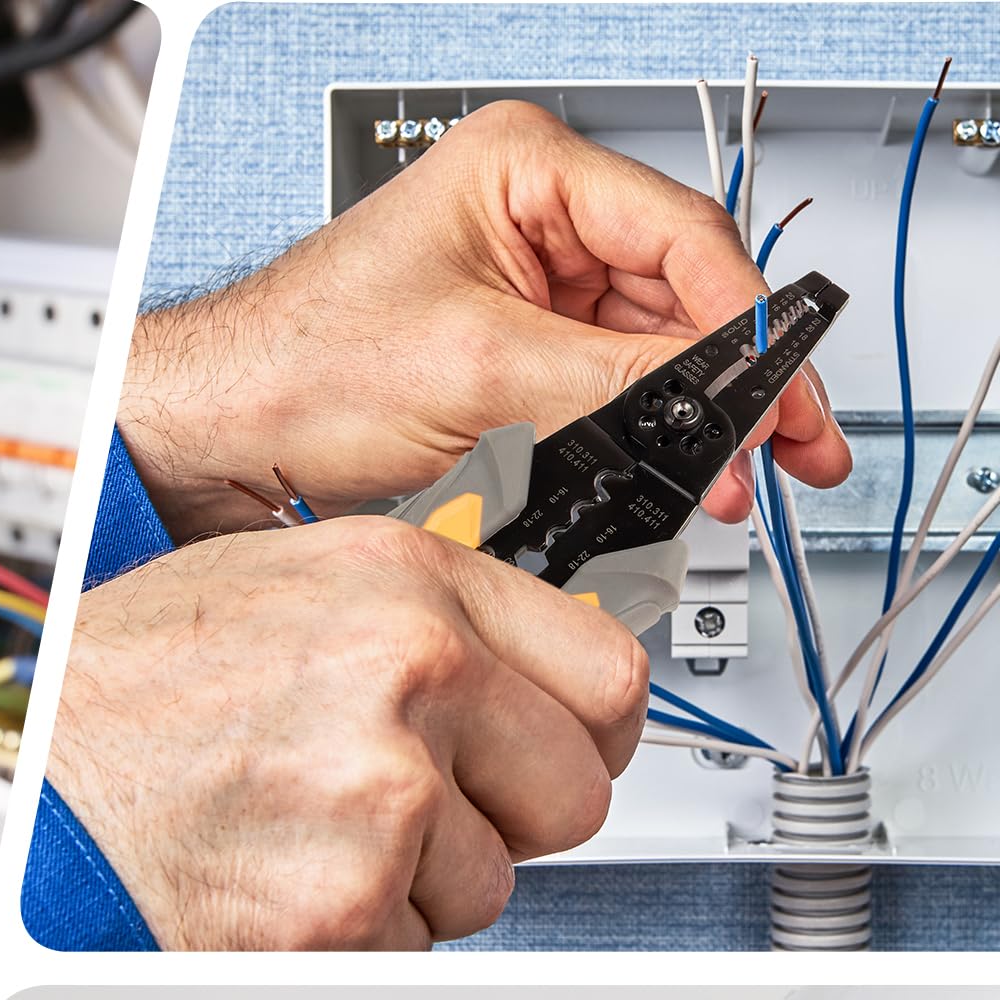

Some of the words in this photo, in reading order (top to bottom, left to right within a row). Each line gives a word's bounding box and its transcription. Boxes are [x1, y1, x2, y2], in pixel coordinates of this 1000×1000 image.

[721, 318, 748, 338] SOLID
[682, 358, 706, 377] SAFETY
[692, 354, 710, 370] WEAR
[768, 352, 800, 384] STRANDED
[674, 363, 700, 385] GLASSES
[558, 446, 590, 473] 410.411
[566, 438, 598, 466] 310.311
[548, 486, 569, 504] 16-10
[627, 502, 662, 530] 410.411
[635, 494, 670, 522] 310.311
[522, 509, 544, 529] 22-18
[595, 524, 618, 544] 16-10
[567, 550, 591, 571] 22-18
